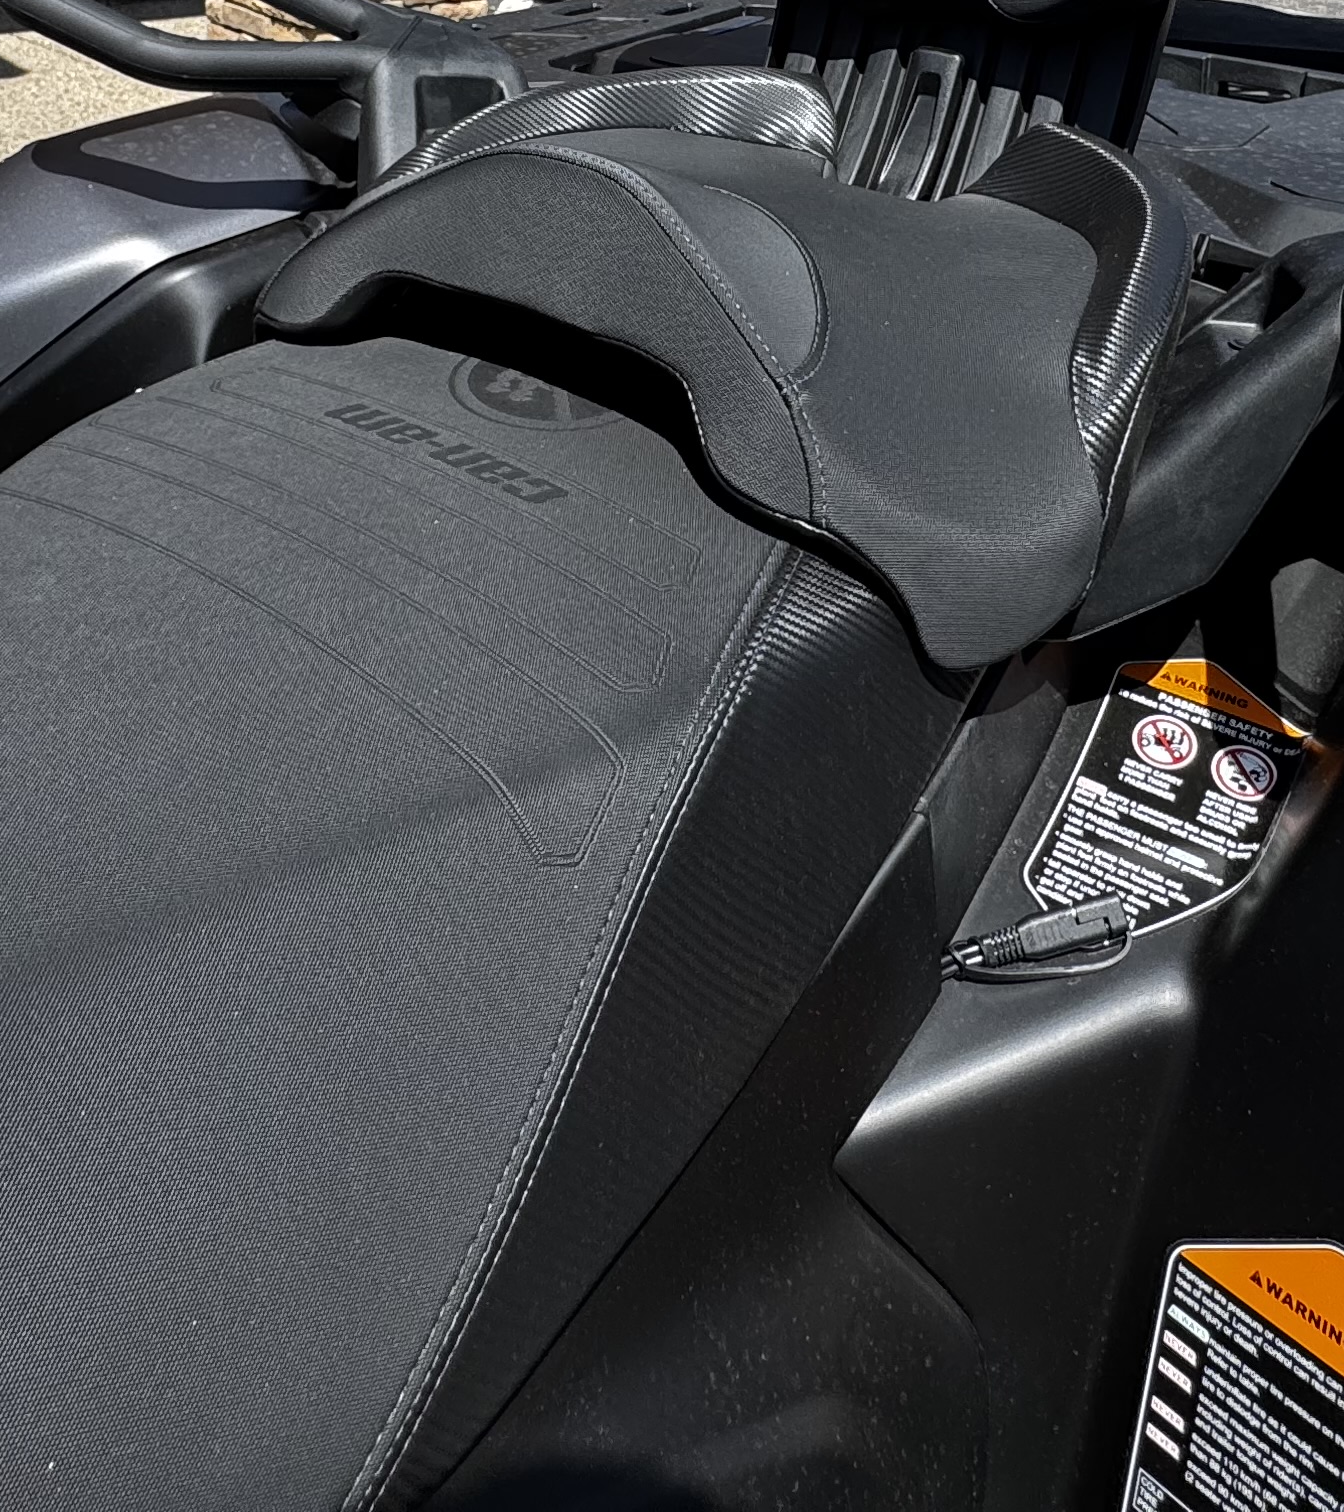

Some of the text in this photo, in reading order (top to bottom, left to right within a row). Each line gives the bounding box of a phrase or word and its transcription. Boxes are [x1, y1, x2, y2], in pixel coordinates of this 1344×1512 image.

[1157, 691, 1274, 740] PASSENGER SAFETY
[1174, 675, 1249, 709] WARNING
[1067, 803, 1086, 818] THE
[1084, 811, 1141, 842] PASSENGER
[1173, 1286, 1200, 1312] severe
[1200, 1306, 1223, 1330] injury
[1222, 1325, 1233, 1337] or
[1178, 1262, 1213, 1295] Improper
[1213, 1289, 1227, 1306] tire
[1226, 1301, 1264, 1334] pressure
[1263, 1329, 1275, 1341] or
[1274, 1337, 1325, 1382] overloading
[1325, 1375, 1344, 1394] can
[1175, 1273, 1192, 1293] loss
[1192, 1288, 1203, 1299] of
[1231, 1316, 1253, 1339] Loss
[1252, 1335, 1264, 1347] of
[1262, 1342, 1293, 1370] control
[1293, 1365, 1310, 1383] can
[1310, 1378, 1337, 1403] result
[1206, 1347, 1230, 1371] Refer
[1229, 1365, 1238, 1379] to
[1208, 1337, 1242, 1369] maintain
[1241, 1363, 1270, 1389] proper
[1269, 1383, 1284, 1401] tire
[1283, 1396, 1322, 1430] pressure
[1321, 1425, 1334, 1440] on
[1196, 1403, 1233, 1440] including
[1233, 1434, 1262, 1462] weight
[1262, 1457, 1273, 1470] of
[1201, 1375, 1216, 1393] tire
[1216, 1386, 1226, 1401] to
[1225, 1396, 1262, 1429] dislodge
[1261, 1422, 1282, 1446] from
[1282, 1439, 1298, 1458] the
[1203, 1365, 1252, 1408] underinflate
[1252, 1402, 1267, 1420] tire
[1267, 1415, 1279, 1430] as
[1279, 1423, 1287, 1436] it
[1286, 1431, 1313, 1455] could
[1312, 1451, 1340, 1477] cause
[1189, 1442, 1208, 1464] than
[1220, 1467, 1233, 1486] kg
[1191, 1432, 1222, 1462] exceed
[1194, 1416, 1212, 1434] and
[1211, 1428, 1236, 1453] trailer
[1235, 1448, 1266, 1479] tongue
[1198, 1392, 1230, 1422] exceed
[1229, 1417, 1271, 1455] maximum
[1271, 1450, 1301, 1479] weight
[1300, 1474, 1339, 1510] capacity
[1140, 1476, 1164, 1501] COLD
[1186, 1459, 1217, 1489] exceed
